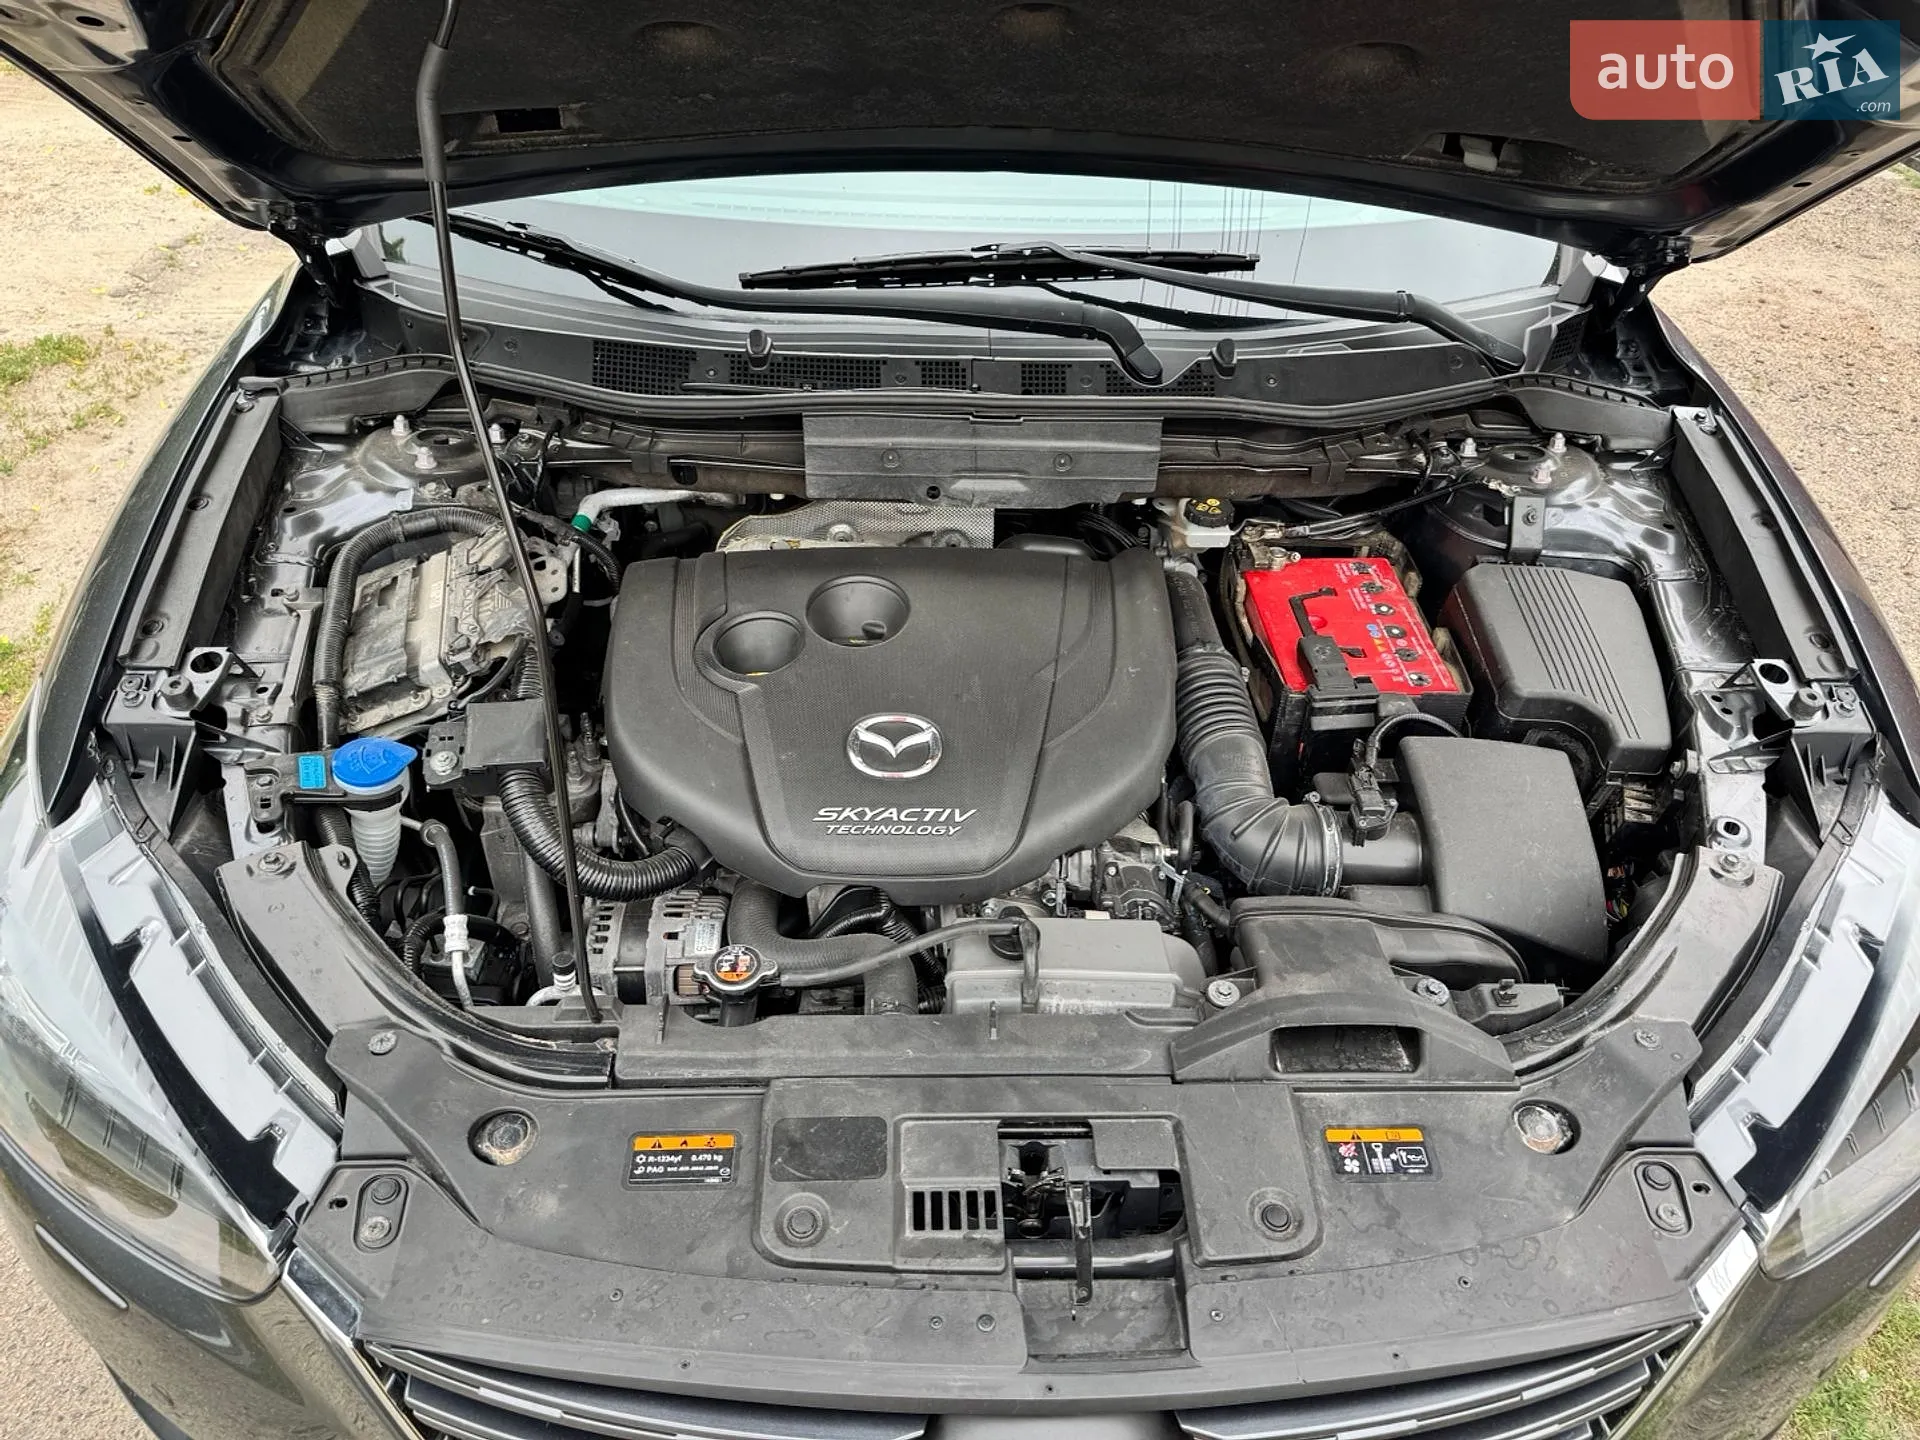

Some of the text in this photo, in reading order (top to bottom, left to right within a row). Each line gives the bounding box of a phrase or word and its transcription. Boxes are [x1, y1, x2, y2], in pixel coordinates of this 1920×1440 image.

[812, 807, 978, 822] SKYACTIV
[826, 825, 962, 835] TECHNOLOGY
[713, 1154, 724, 1163] kg
